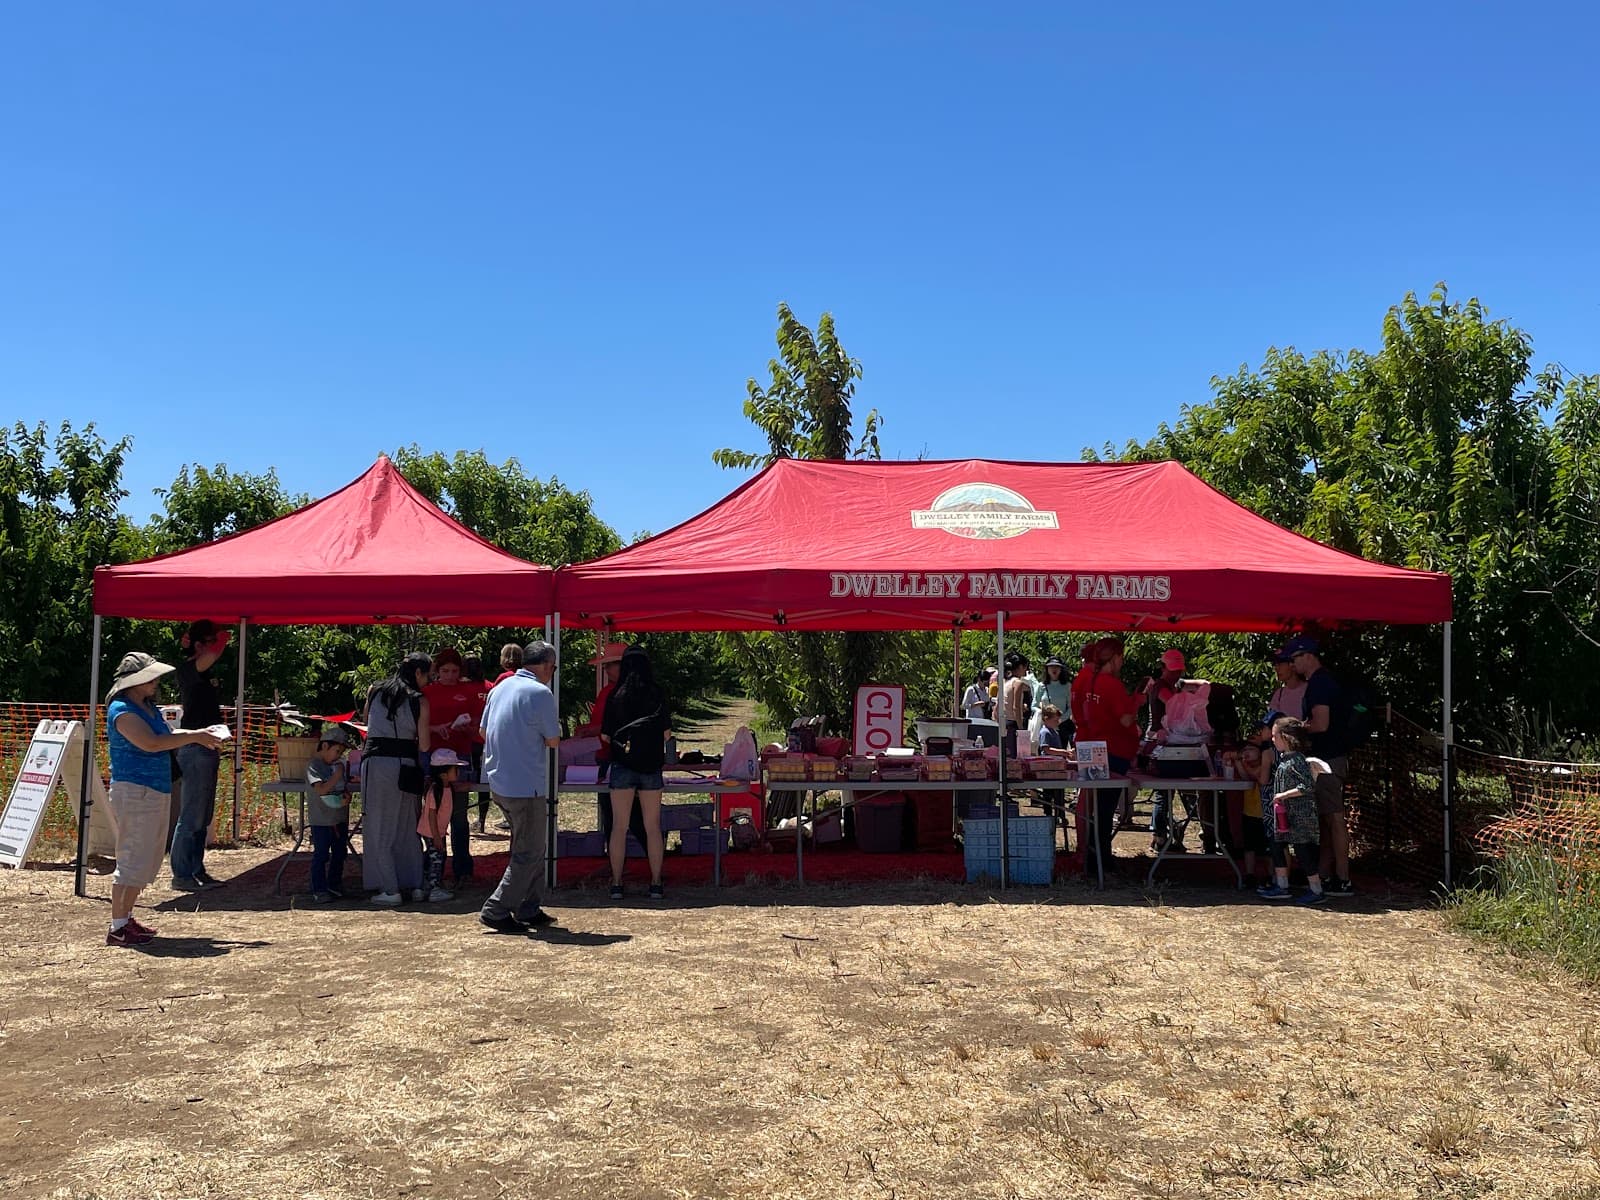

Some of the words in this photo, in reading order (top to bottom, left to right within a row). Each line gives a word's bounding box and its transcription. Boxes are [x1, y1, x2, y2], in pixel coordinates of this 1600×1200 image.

[829, 572, 964, 598] DWELLEY
[968, 573, 1072, 599] FAMILY
[1076, 574, 1172, 601] FARMS
[865, 691, 893, 756] CLO
